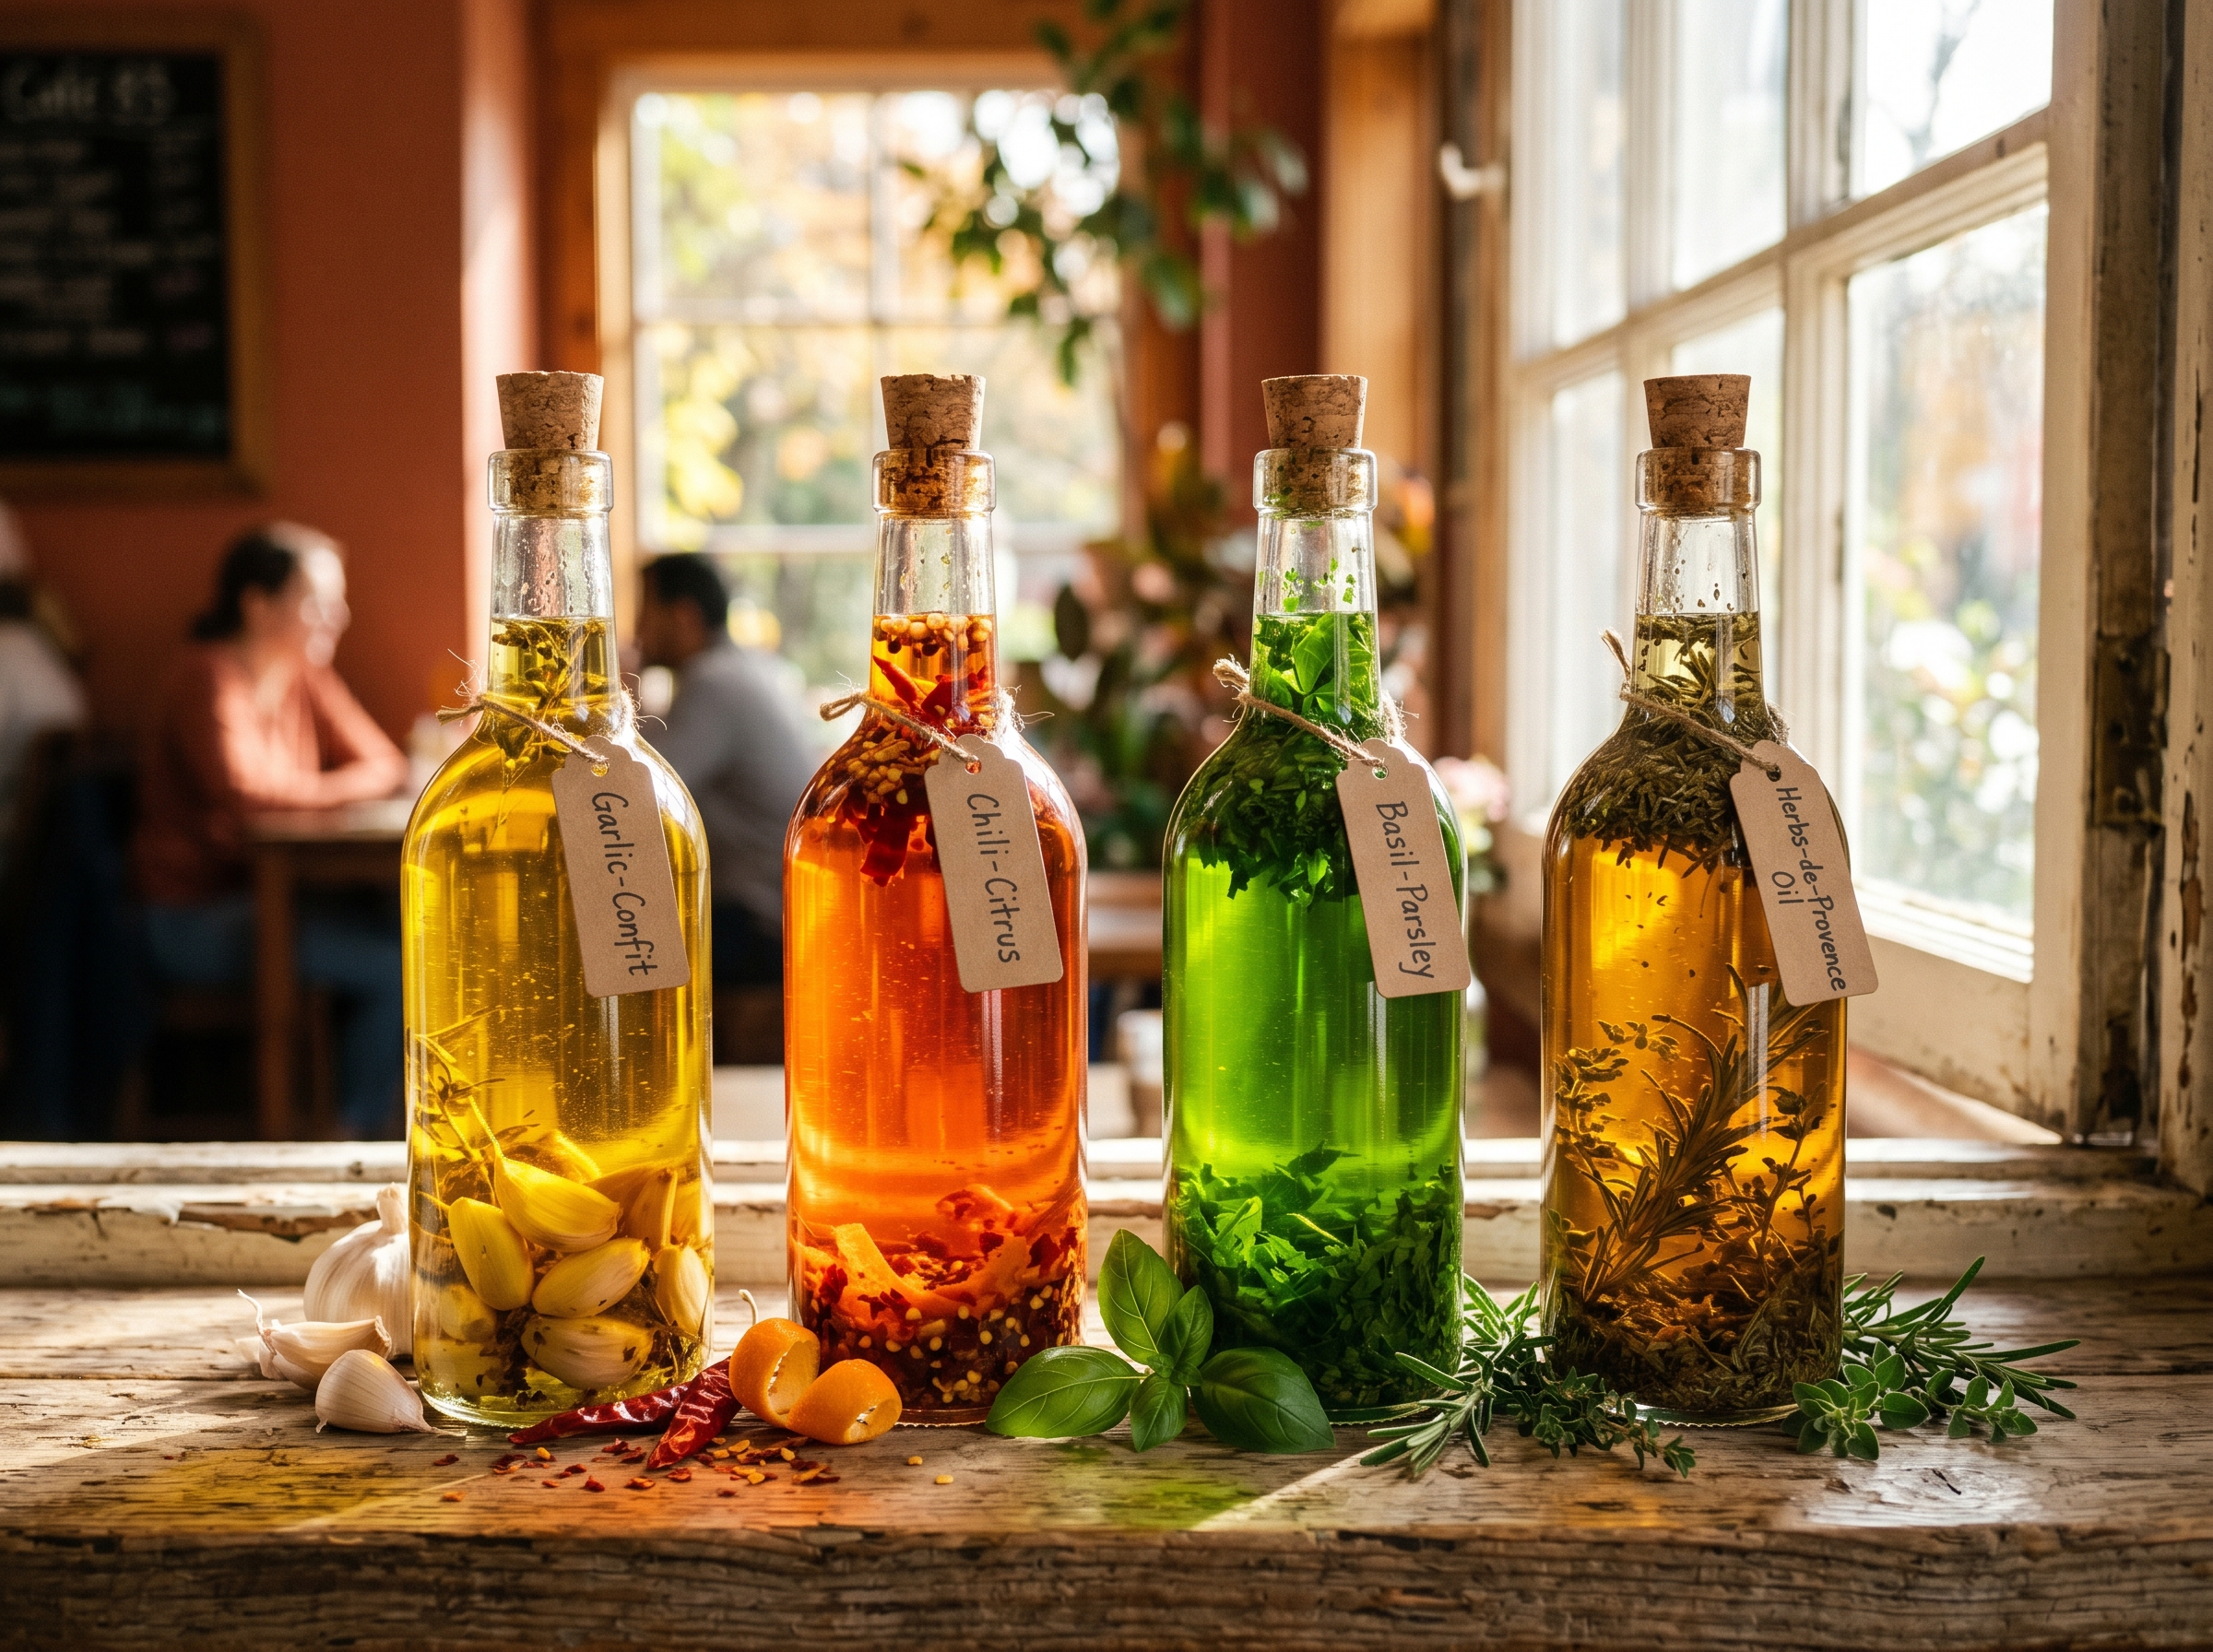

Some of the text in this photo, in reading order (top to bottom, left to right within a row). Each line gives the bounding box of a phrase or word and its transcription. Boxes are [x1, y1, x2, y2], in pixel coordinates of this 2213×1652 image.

[592, 792, 658, 975] Garlic-Confit
[966, 793, 1020, 962] Chili-Citrus
[1375, 800, 1437, 979] Basil-Parsley
[1771, 870, 1805, 904] Oil
[1776, 786, 1846, 991] Herbs-de-Provence
